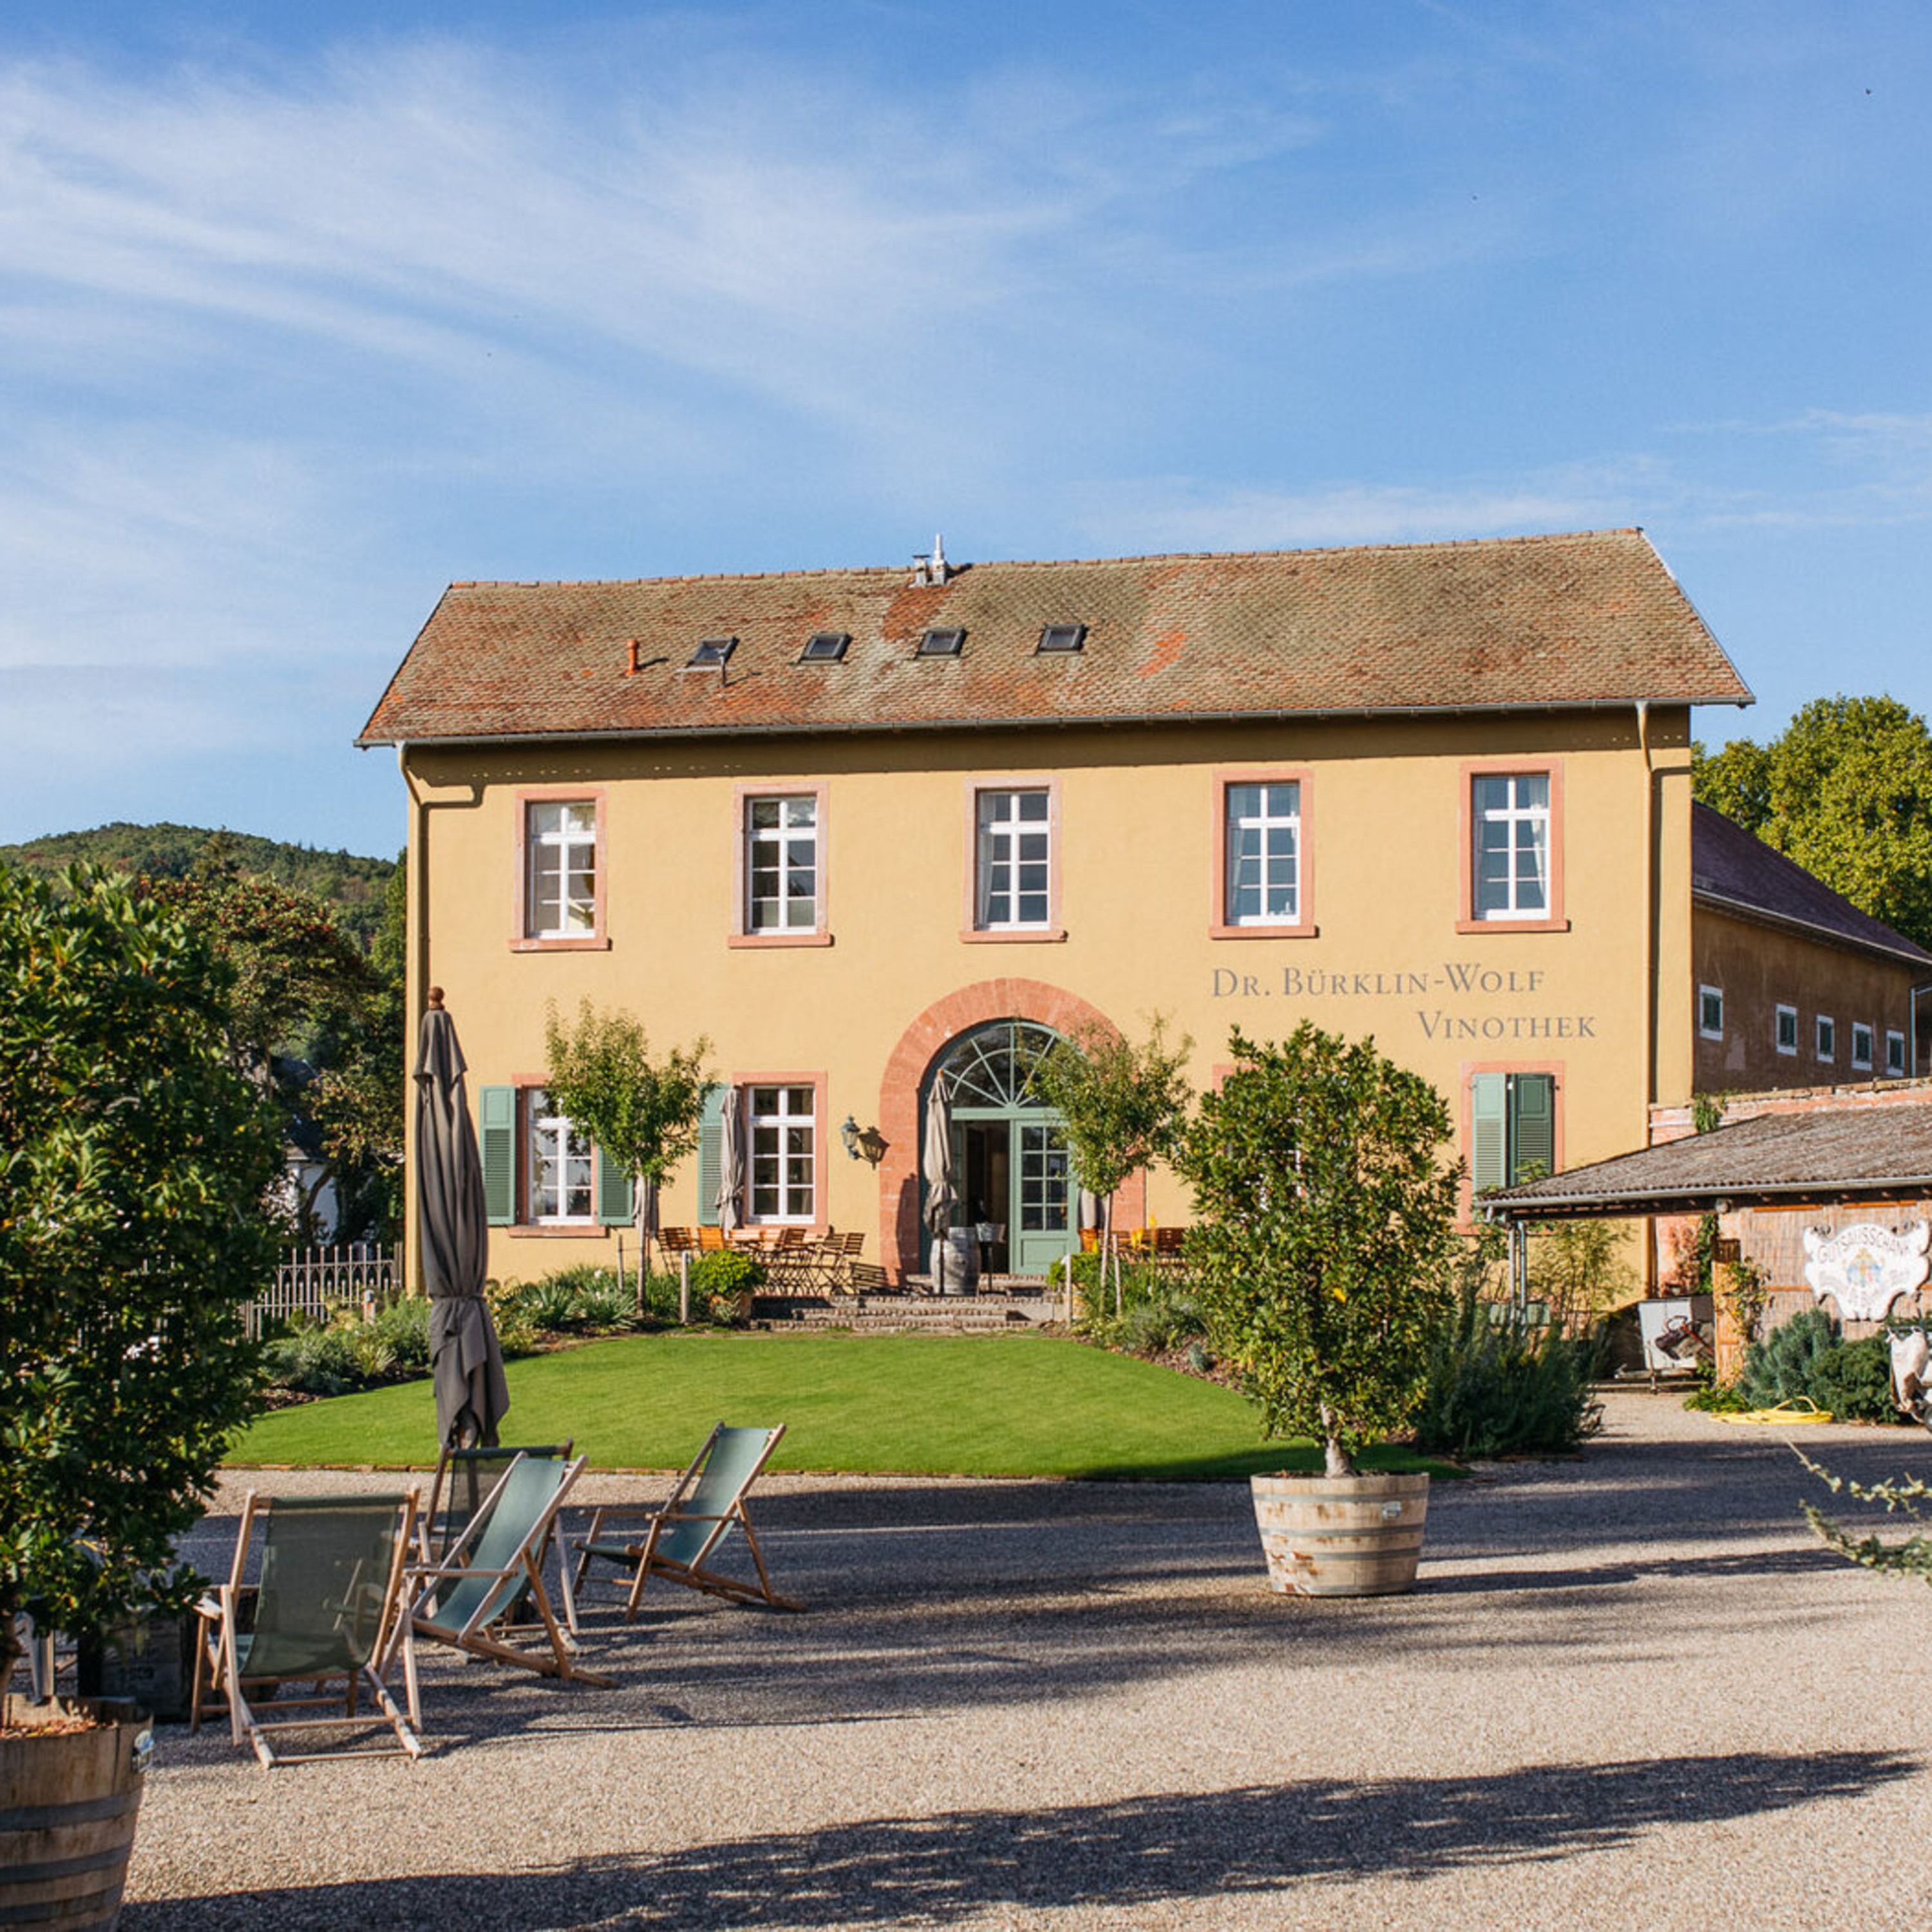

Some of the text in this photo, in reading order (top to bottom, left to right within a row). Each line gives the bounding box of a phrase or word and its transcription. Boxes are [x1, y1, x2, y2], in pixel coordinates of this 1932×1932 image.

[1212, 962, 1545, 998] DR. BÜRKLIN-WOLF
[1417, 1010, 1596, 1039] VINOTHEK
